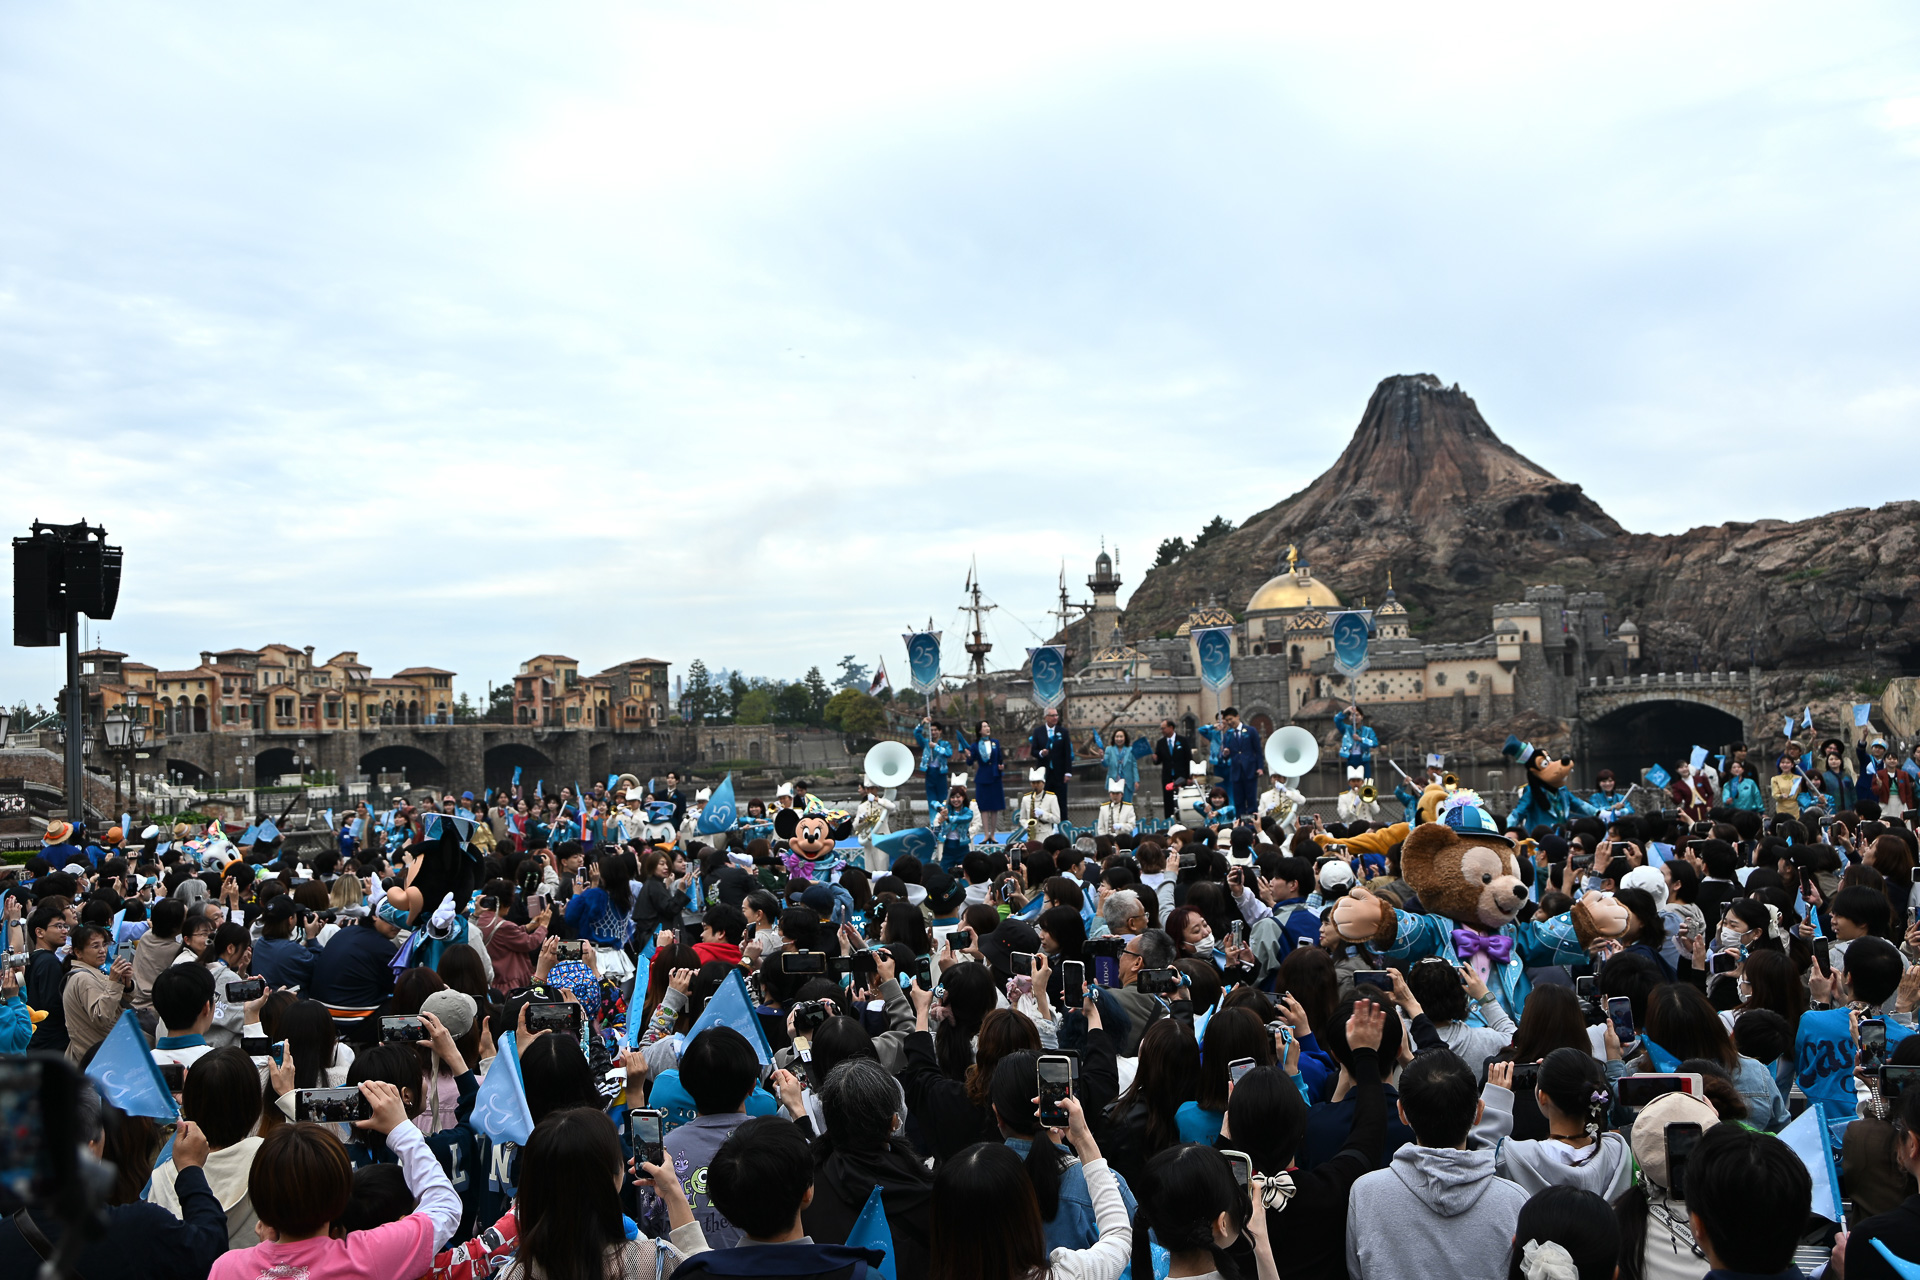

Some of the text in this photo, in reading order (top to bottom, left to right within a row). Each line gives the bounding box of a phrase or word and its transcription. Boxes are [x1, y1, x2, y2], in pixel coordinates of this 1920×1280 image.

[1338, 626, 1361, 649] 25
[914, 646, 934, 668] 25
[1204, 643, 1224, 665] 25
[1037, 660, 1057, 682] 25
[709, 804, 730, 824] 25
[704, 1212, 729, 1233] the
